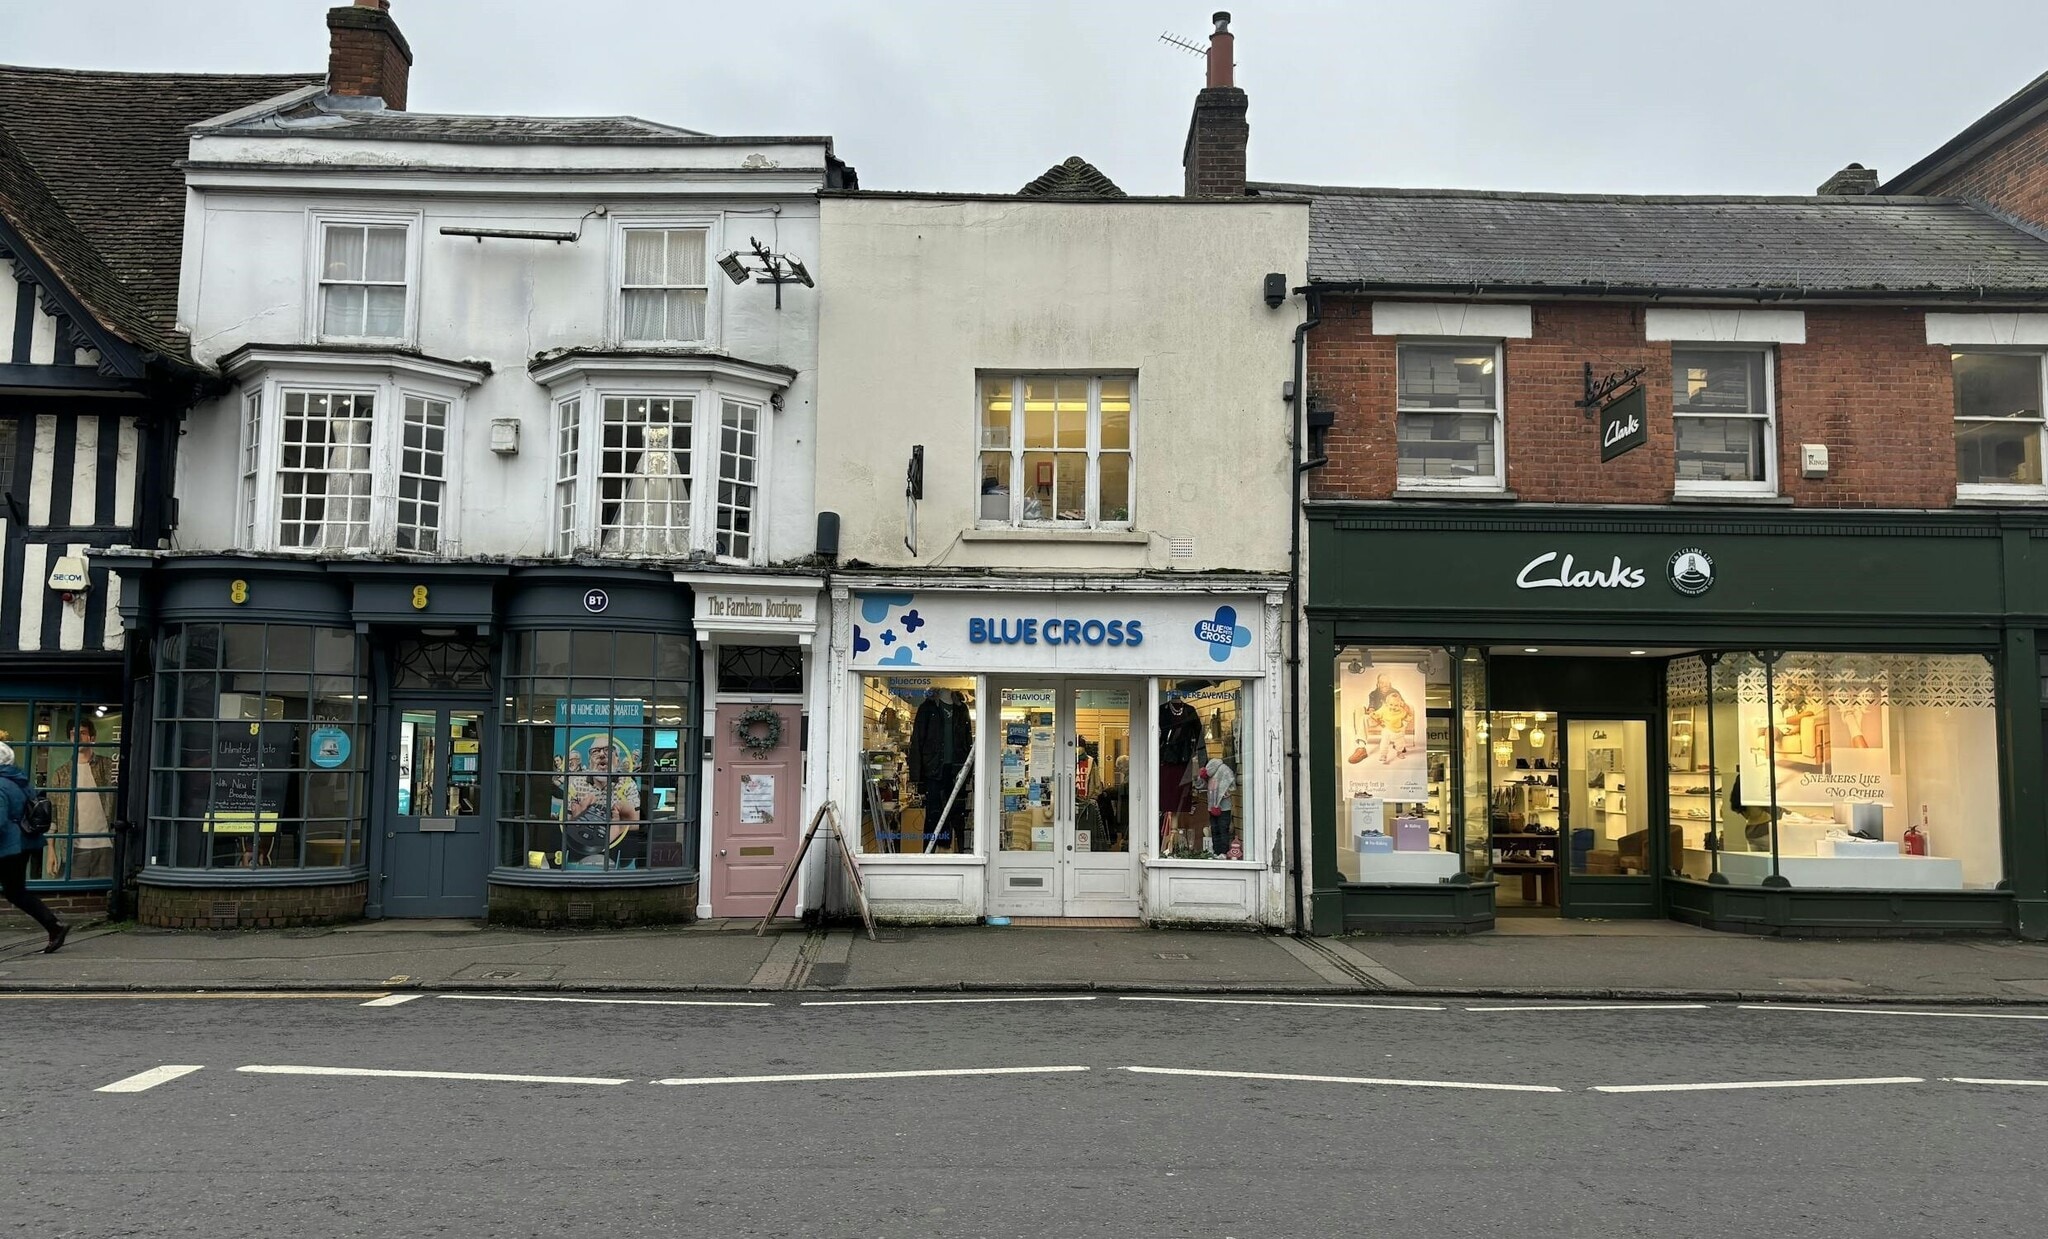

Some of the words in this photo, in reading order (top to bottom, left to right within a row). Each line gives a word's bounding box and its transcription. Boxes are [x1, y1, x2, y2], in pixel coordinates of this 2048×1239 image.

[1604, 414, 1640, 448] Clarks
[1516, 551, 1646, 588] Clarks
[53, 573, 82, 582] SECOM
[589, 595, 604, 606] BT
[708, 595, 725, 616] The
[726, 596, 763, 618] Farnham
[765, 597, 803, 622] Boutique
[969, 617, 1038, 645] BLUE
[1042, 618, 1144, 648] CROSS
[1201, 621, 1225, 634] BLUE
[1199, 630, 1233, 644] CROSS
[1006, 693, 1051, 701] BEHAVIOUR
[560, 703, 577, 715] YR
[577, 703, 594, 716] HOME
[594, 704, 610, 716] RUNS
[1800, 771, 1857, 787] SNEAKERS
[1858, 773, 1881, 788] LIKE
[228, 789, 258, 800] Broadban
[1825, 787, 1846, 798] NO
[1848, 787, 1885, 799] OTHER
